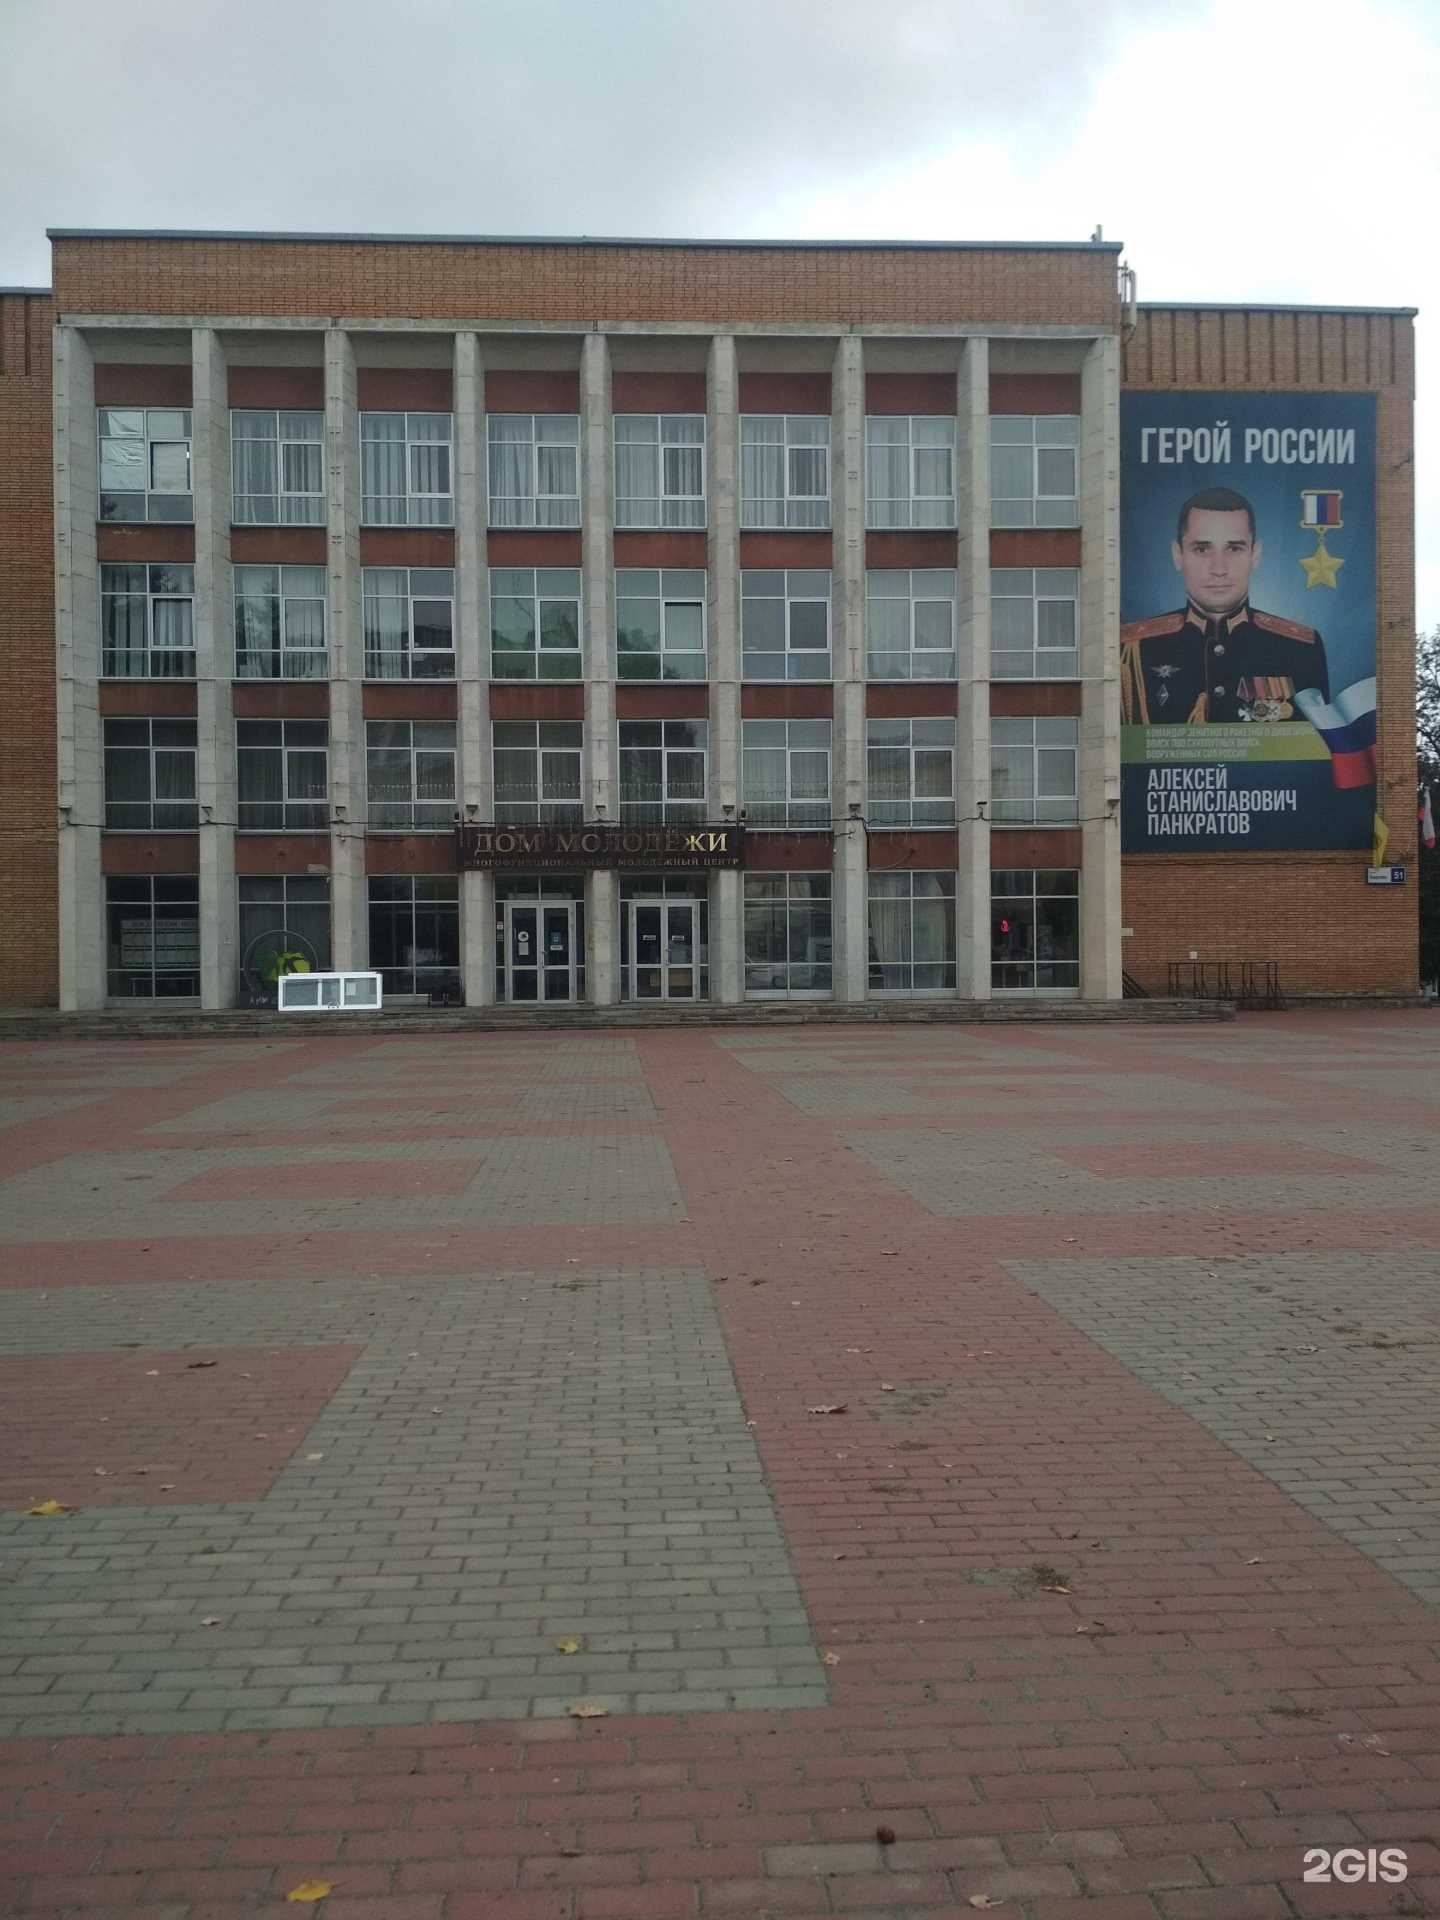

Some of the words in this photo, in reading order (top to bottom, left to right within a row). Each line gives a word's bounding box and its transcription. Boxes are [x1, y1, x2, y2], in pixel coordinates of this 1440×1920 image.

[1141, 420, 1231, 464] ГЕРОЙ
[1245, 428, 1355, 464] РОССИИ
[1148, 763, 1227, 790] АЛЕКСЕЙ
[1147, 790, 1297, 812] СТАНИСЛАВОВИЧ
[1147, 813, 1250, 835] ПАНКРАТОВ
[474, 833, 544, 856] ДОМ
[1393, 871, 1403, 880] 51
